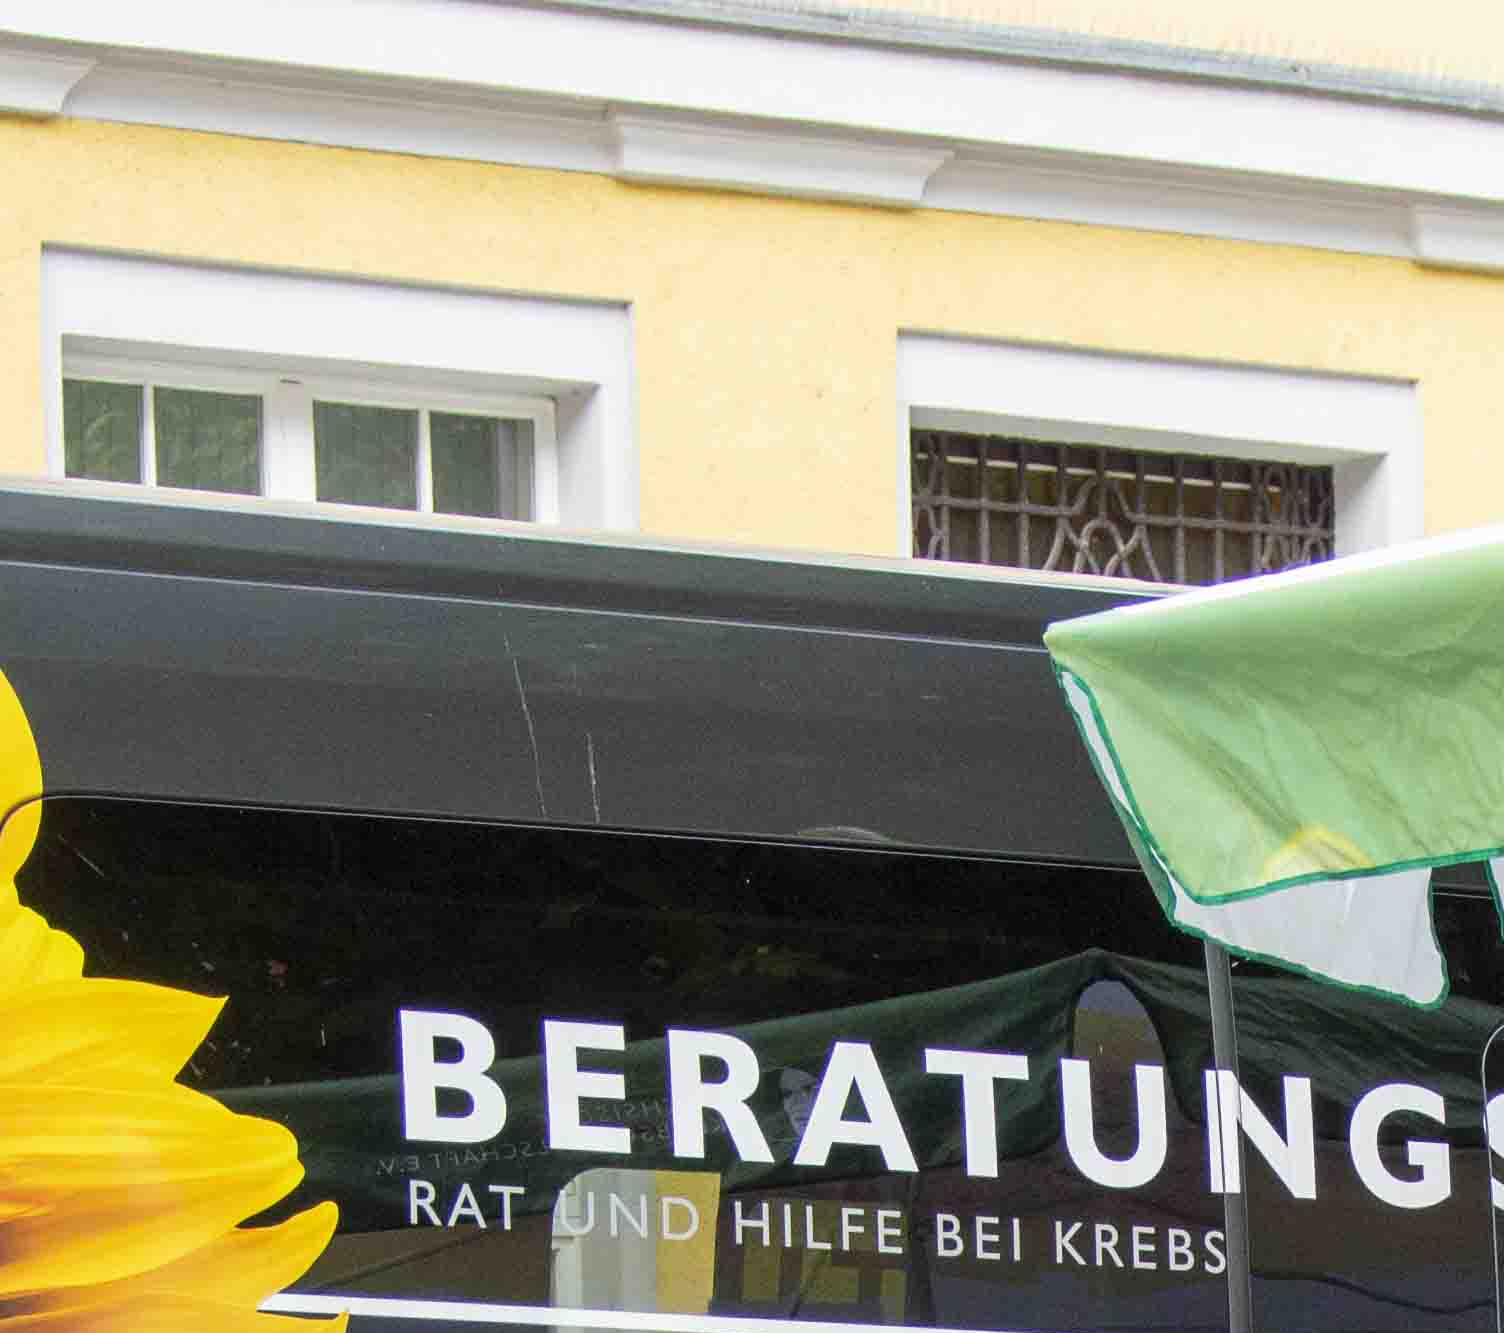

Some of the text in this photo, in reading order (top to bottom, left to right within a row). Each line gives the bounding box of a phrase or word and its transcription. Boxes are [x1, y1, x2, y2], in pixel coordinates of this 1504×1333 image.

[409, 1179, 1229, 1275] RAT UND HILFE BEI KREBS
